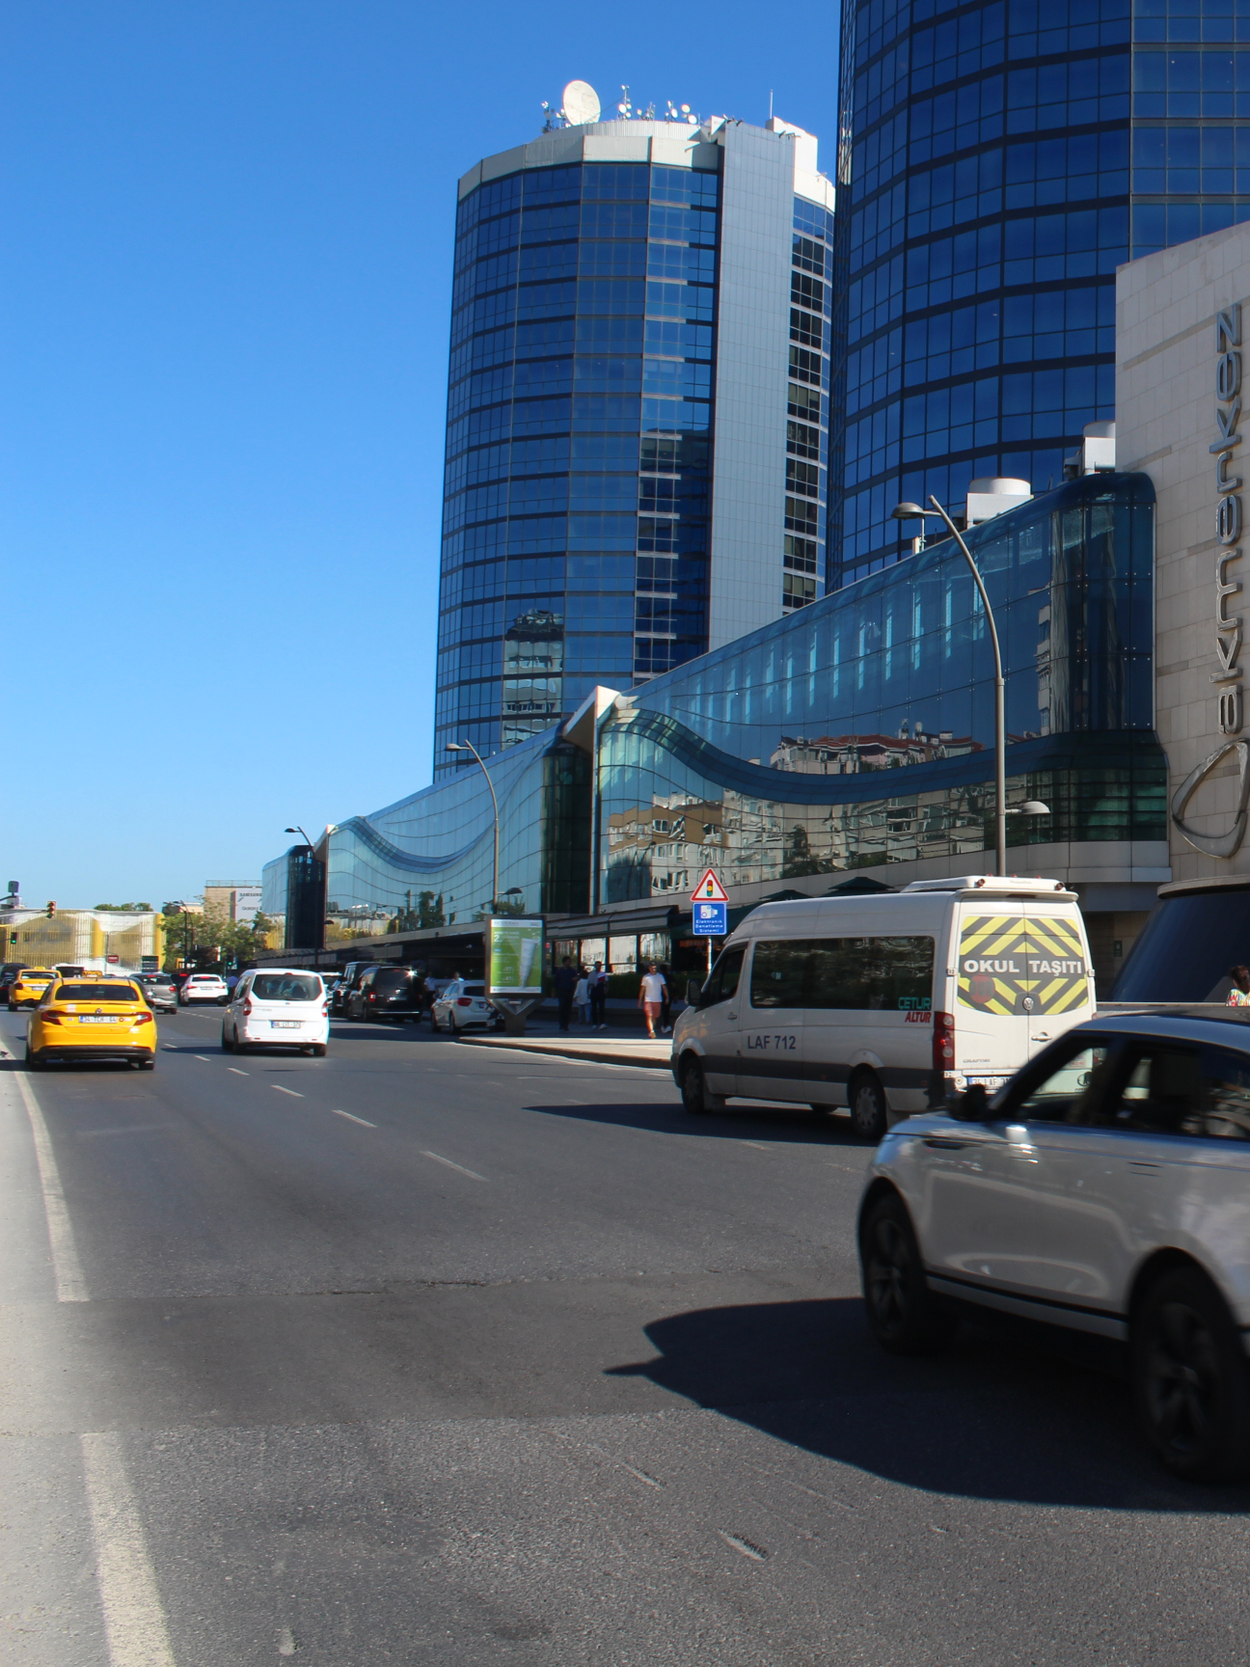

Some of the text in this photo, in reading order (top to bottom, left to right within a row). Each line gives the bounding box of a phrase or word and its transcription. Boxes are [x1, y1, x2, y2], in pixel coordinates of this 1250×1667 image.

[1209, 303, 1243, 735] akmerkez
[963, 959, 1082, 976] OKUL TAŞITI
[904, 1011, 931, 1023] ALTUR
[747, 1035, 796, 1049] LAF 712
